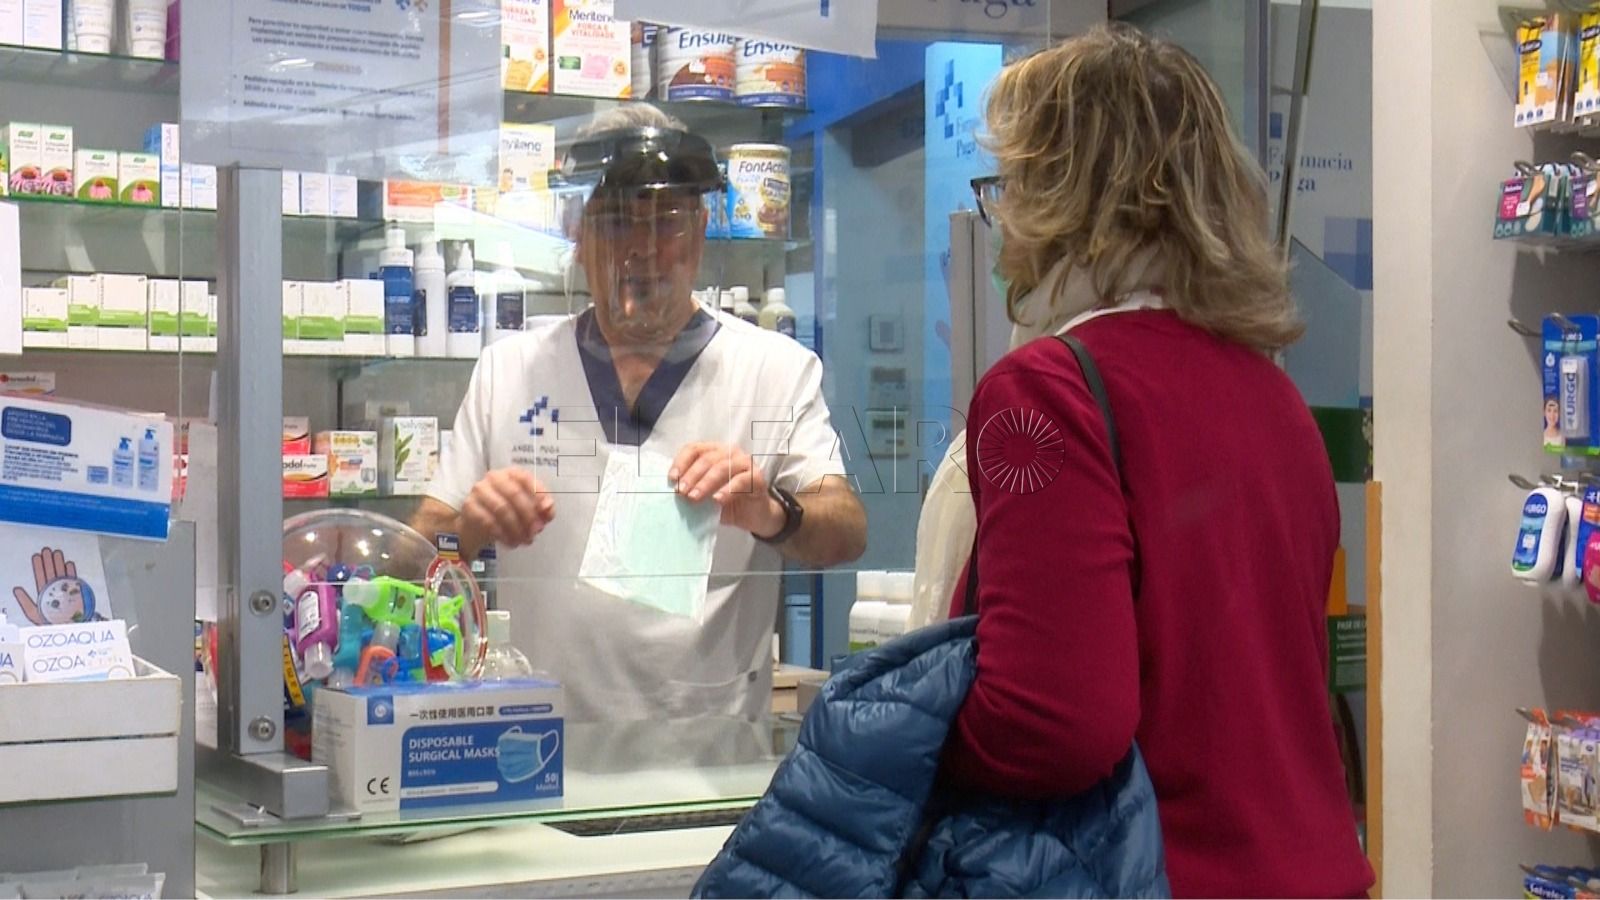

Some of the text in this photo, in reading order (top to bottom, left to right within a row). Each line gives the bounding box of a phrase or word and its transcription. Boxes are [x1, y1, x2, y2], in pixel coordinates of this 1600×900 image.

[27, 629, 115, 649] OZOAQUA
[408, 735, 475, 750] DISPOSABLE
[408, 747, 500, 764] SURGICAL MASKS
